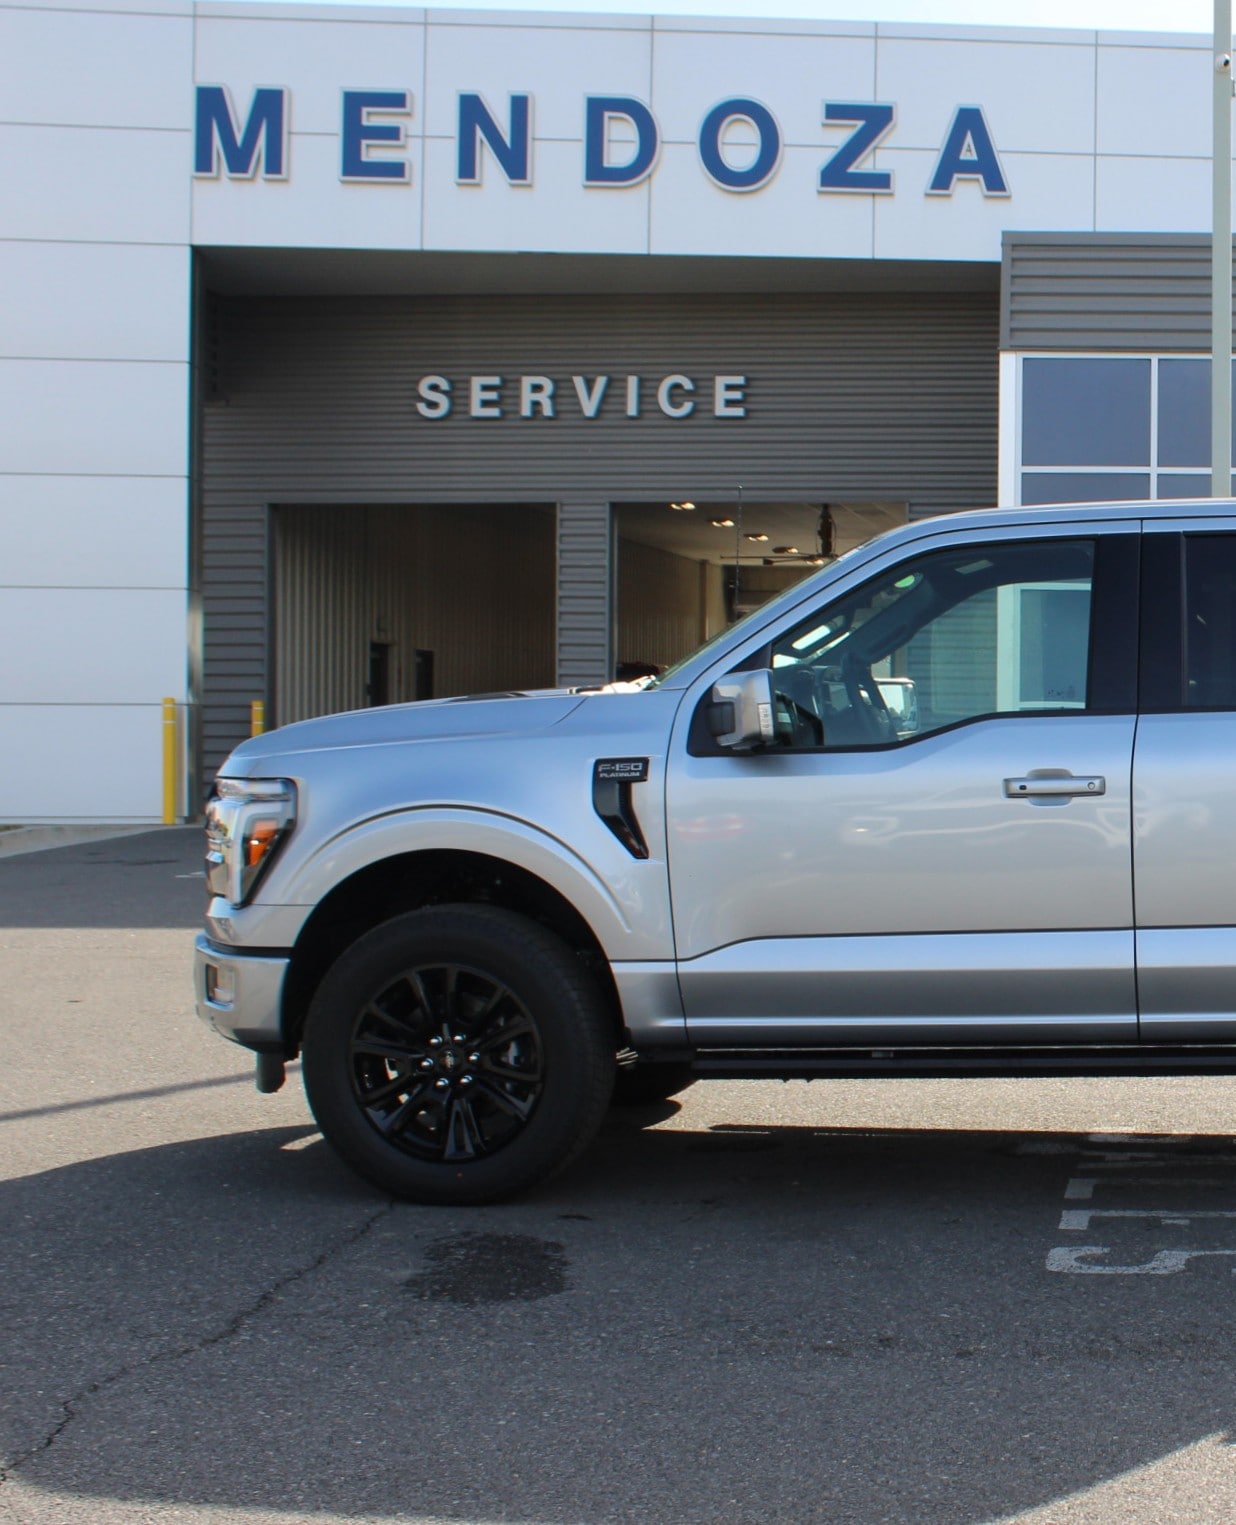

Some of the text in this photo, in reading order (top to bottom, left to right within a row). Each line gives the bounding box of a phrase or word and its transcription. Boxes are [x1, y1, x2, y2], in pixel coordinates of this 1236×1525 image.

[194, 85, 1010, 197] MENDOZA
[416, 375, 749, 418] SERVICE
[598, 762, 643, 771] F-150
